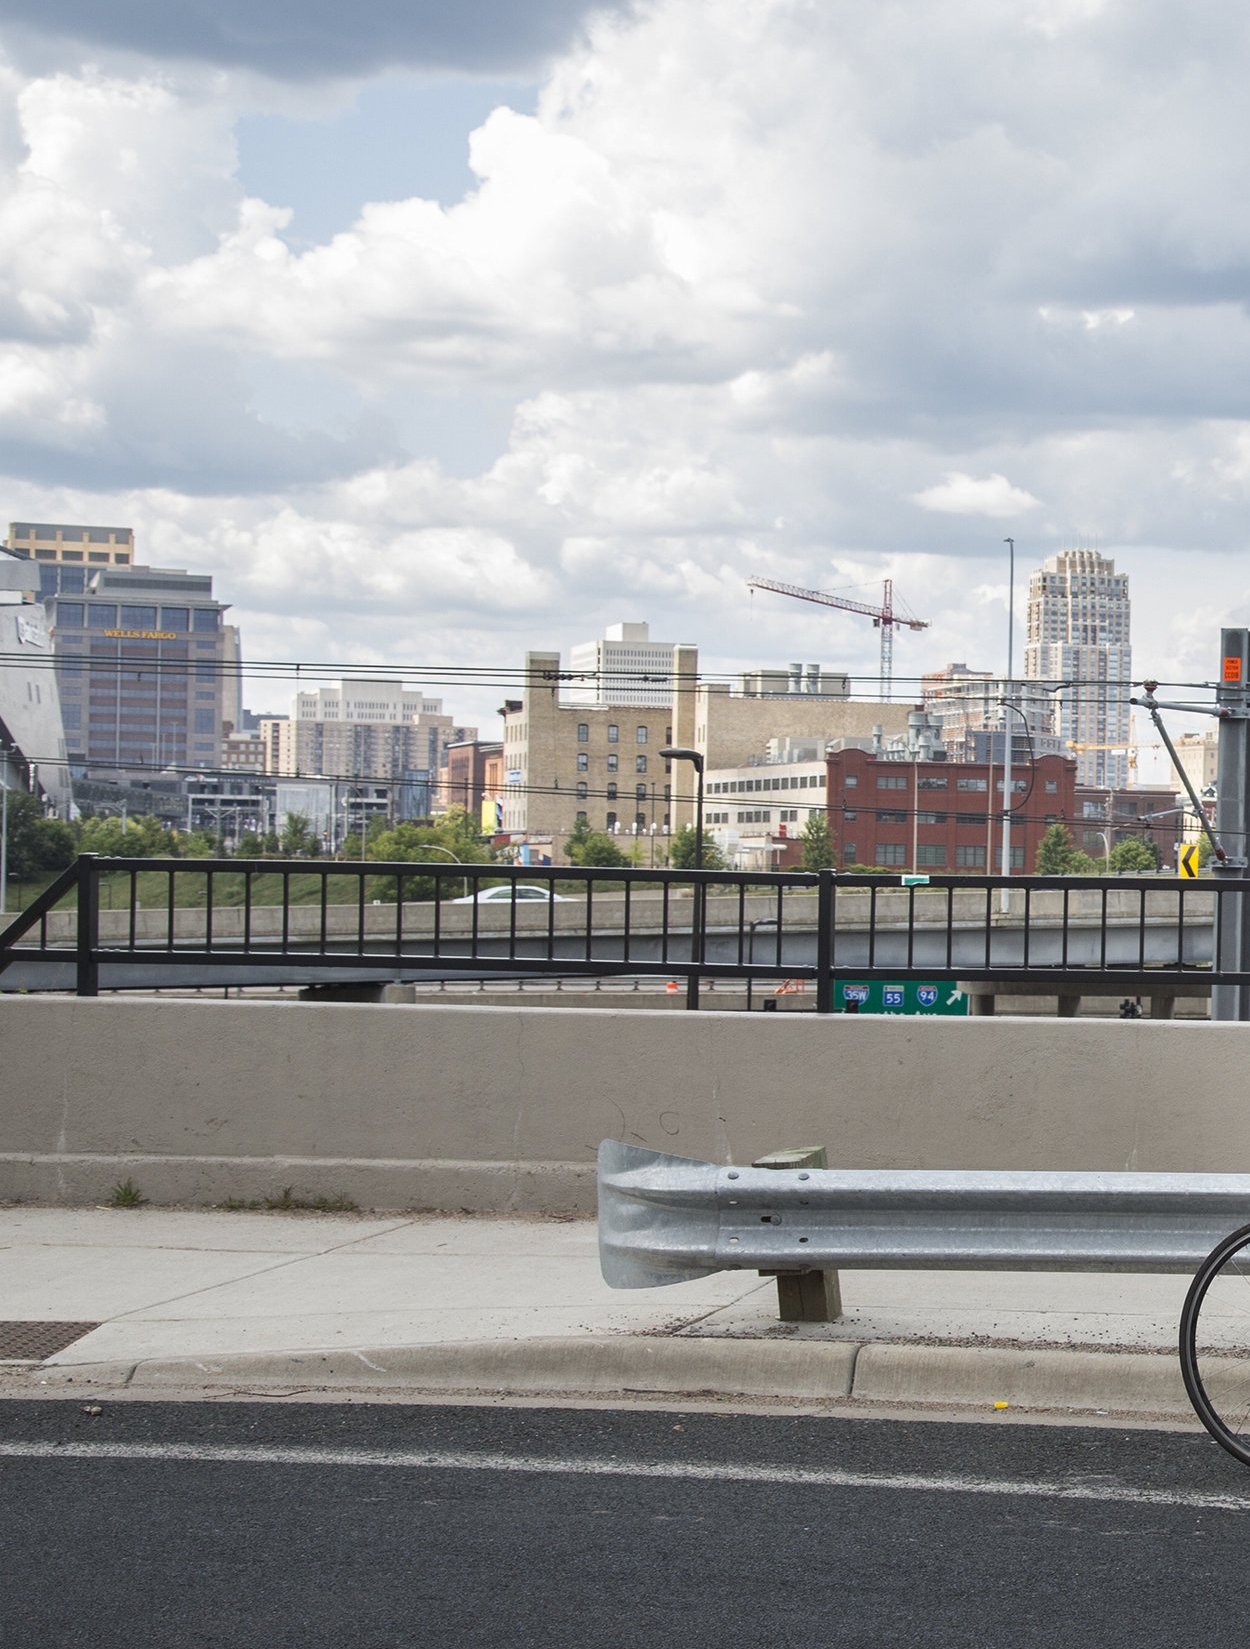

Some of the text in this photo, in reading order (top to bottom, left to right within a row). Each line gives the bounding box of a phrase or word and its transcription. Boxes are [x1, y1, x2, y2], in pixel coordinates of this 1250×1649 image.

[103, 628, 177, 640] WELLS FARGO
[846, 990, 867, 1000] 35W
[886, 993, 901, 1004] 55
[920, 991, 935, 1001] 94
